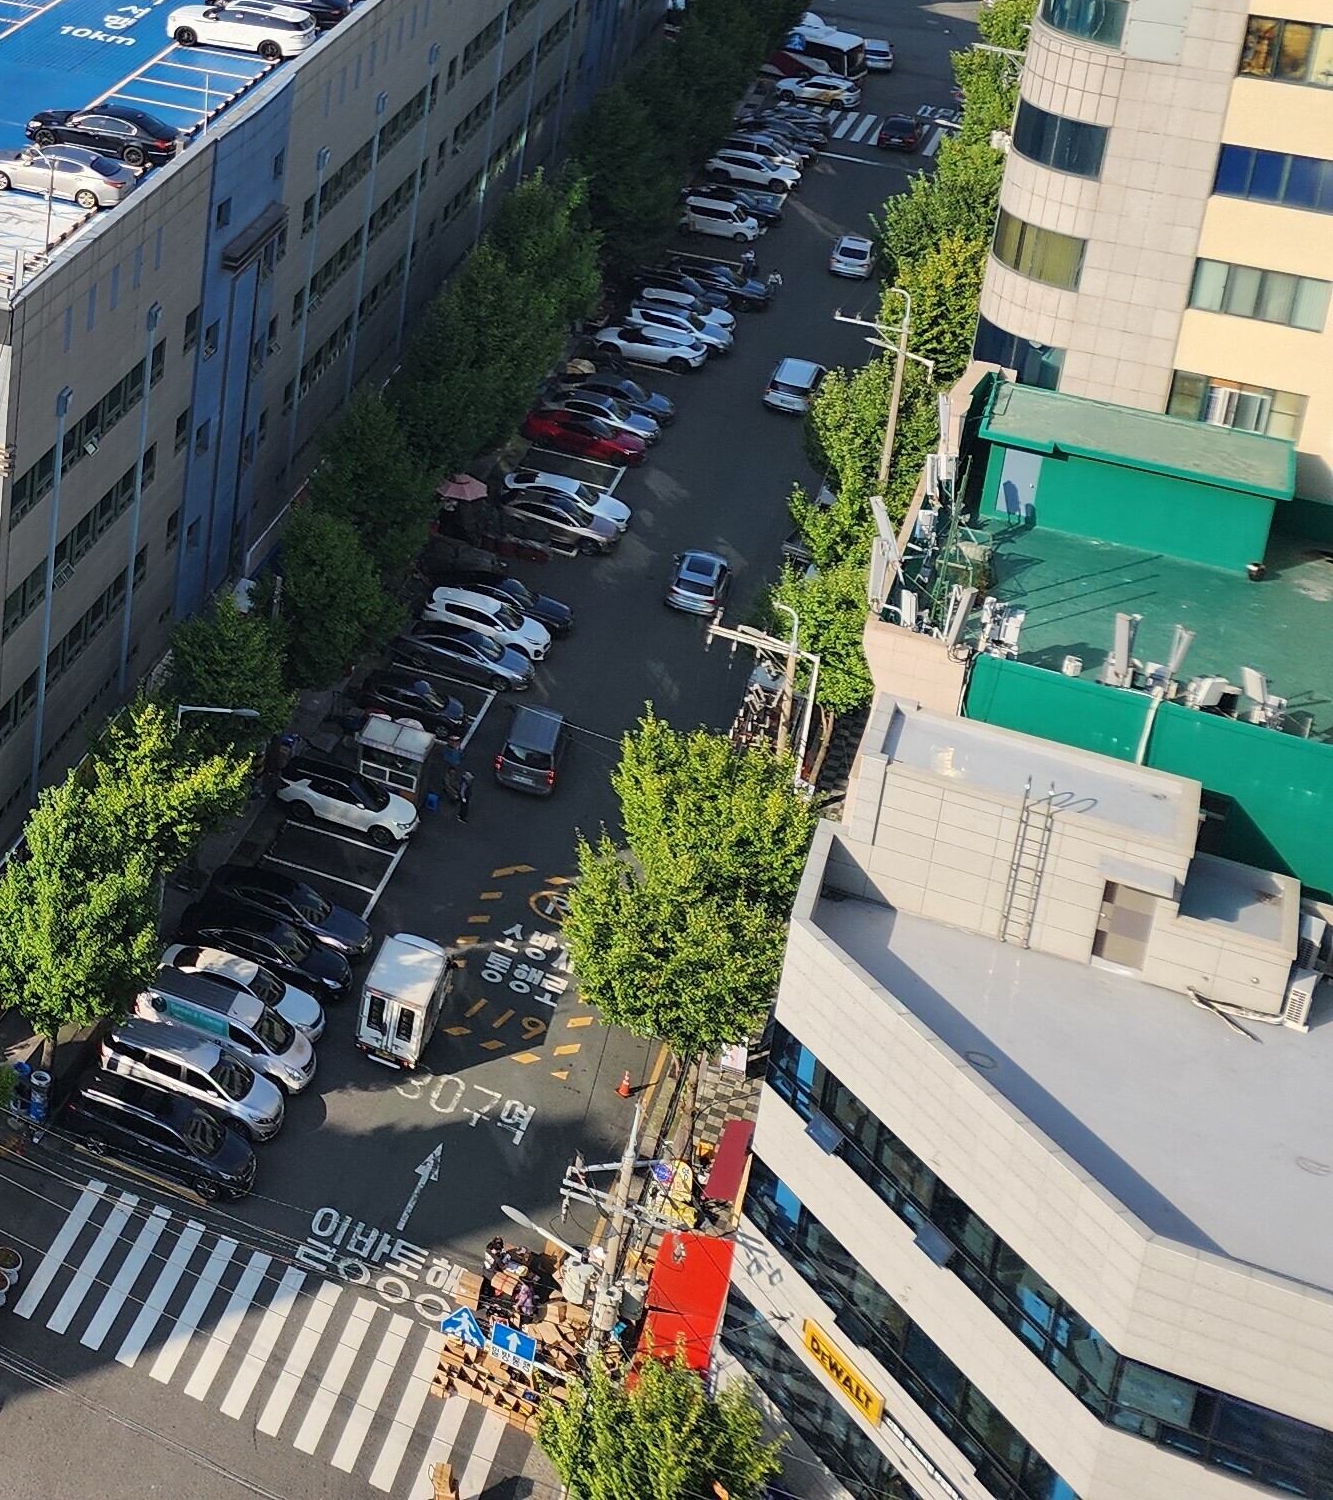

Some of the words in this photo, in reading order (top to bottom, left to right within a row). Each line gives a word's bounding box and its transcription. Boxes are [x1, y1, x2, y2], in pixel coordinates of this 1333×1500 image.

[60, 25, 136, 47] 10km
[481, 951, 569, 1008] 통행로
[465, 997, 548, 1040] 119
[295, 1207, 470, 1323] 일방통행
[491, 1345, 531, 1373] 일방통행
[810, 1334, 873, 1410] DEWALT
